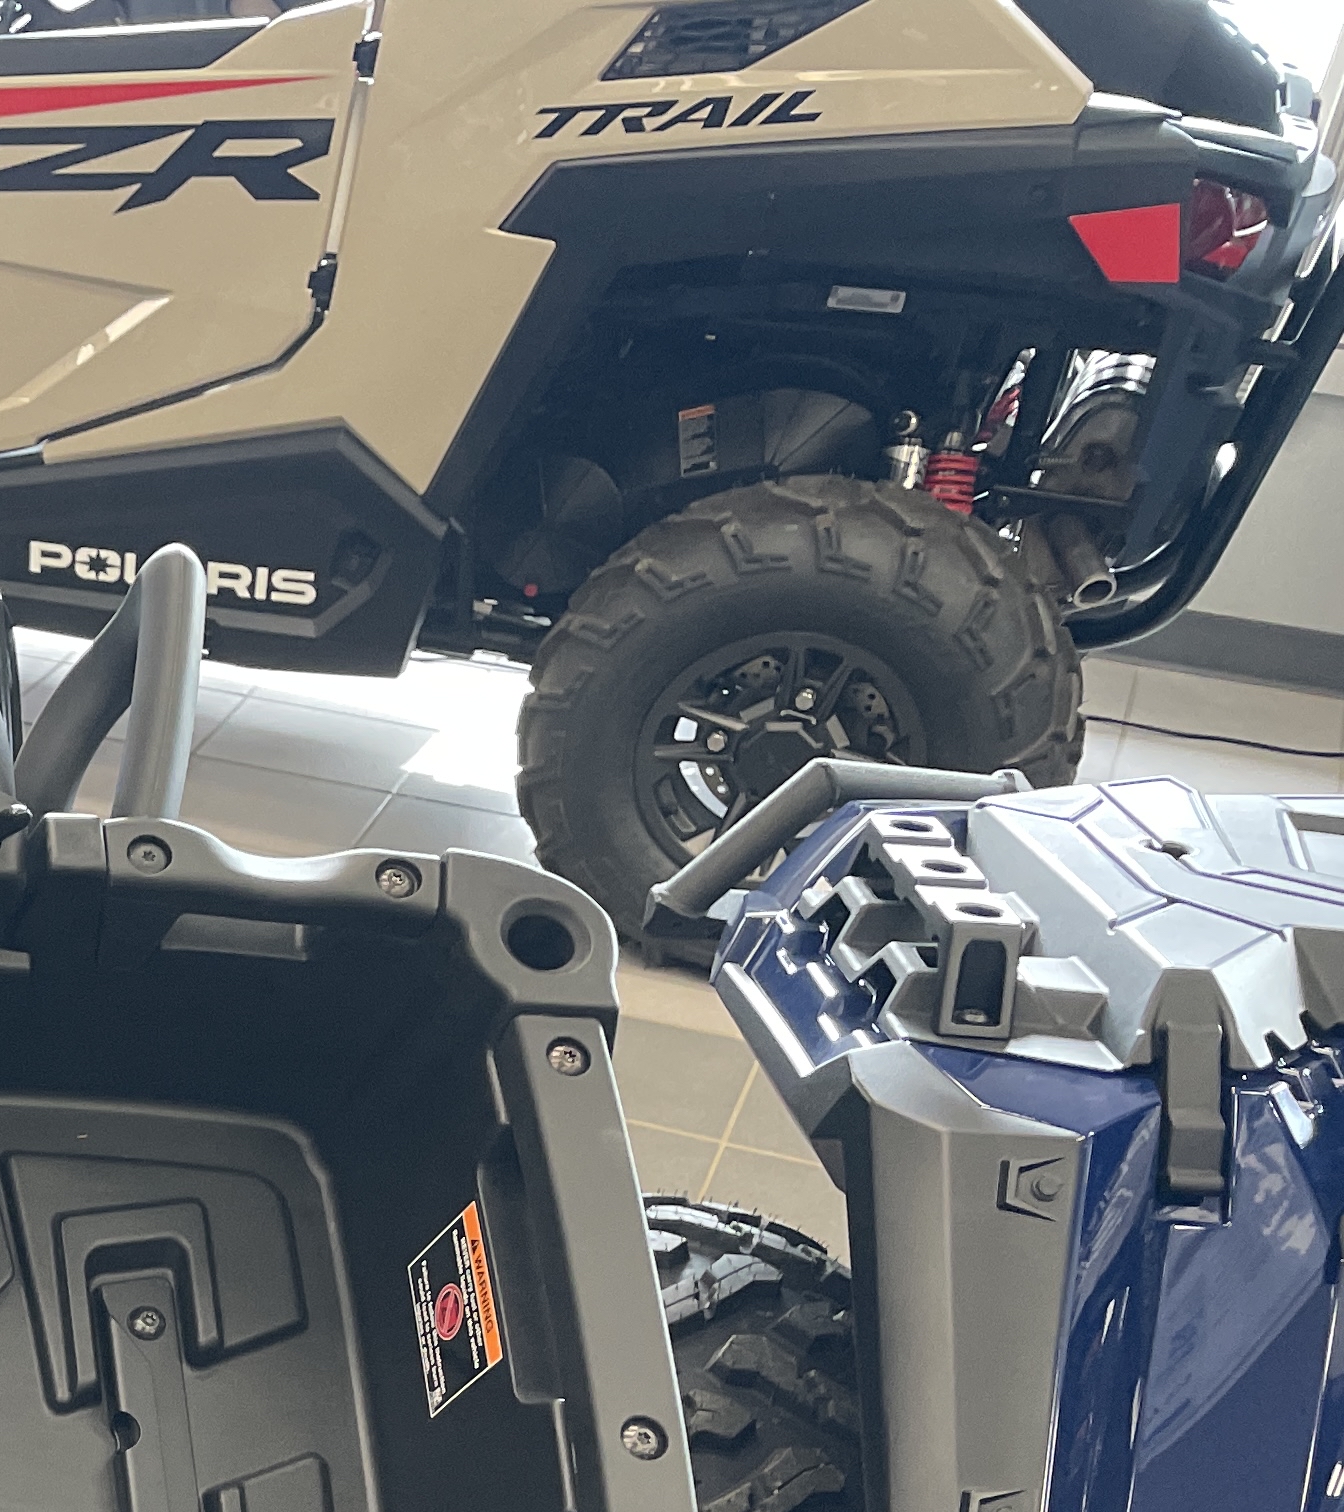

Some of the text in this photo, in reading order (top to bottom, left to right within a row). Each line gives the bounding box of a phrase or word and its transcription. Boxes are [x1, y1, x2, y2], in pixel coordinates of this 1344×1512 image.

[533, 89, 823, 139] TRAIL
[28, 540, 317, 605] POLRIS
[475, 1254, 494, 1333] WARNING
